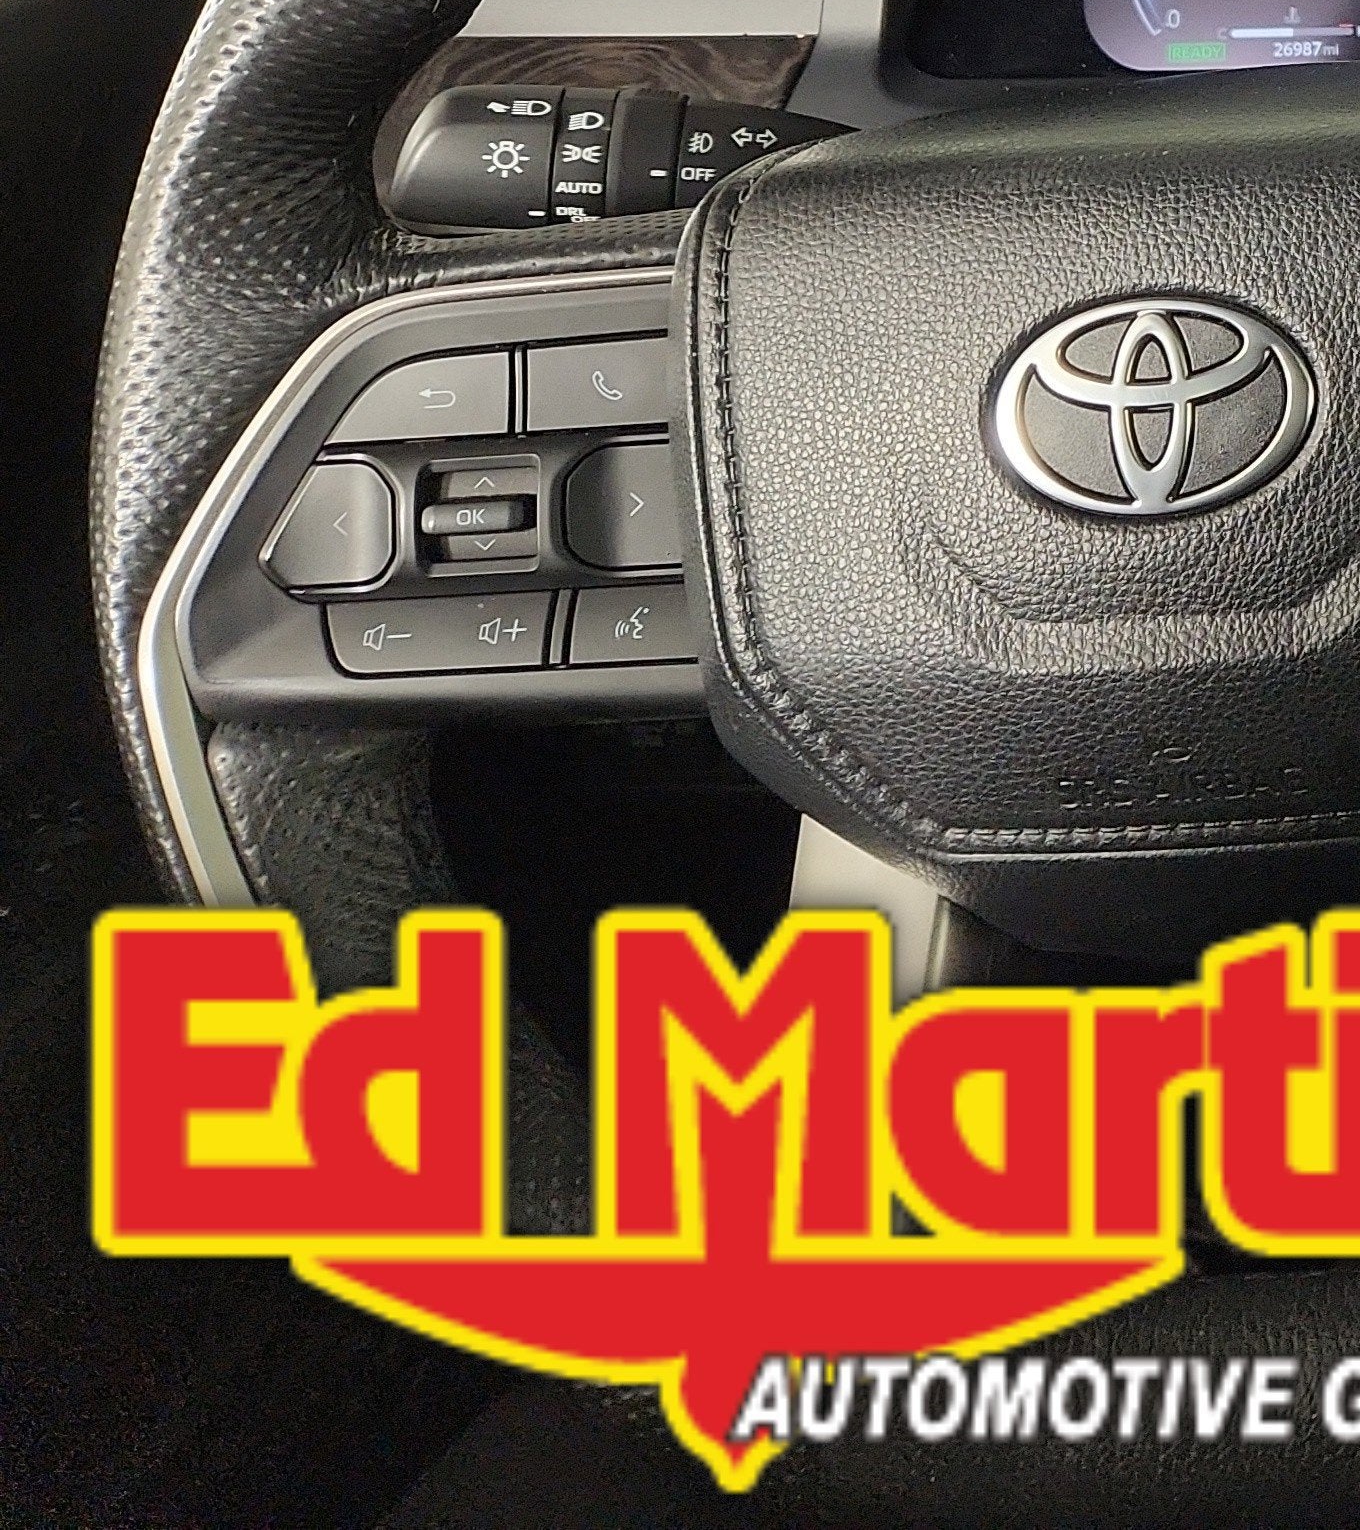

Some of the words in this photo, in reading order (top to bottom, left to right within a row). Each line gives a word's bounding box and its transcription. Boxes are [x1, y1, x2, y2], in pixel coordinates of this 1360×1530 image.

[1167, 9, 1182, 29] 0
[680, 166, 717, 183] OFF
[555, 181, 603, 195] AUTO
[555, 206, 587, 217] DRL
[455, 508, 486, 526] OK
